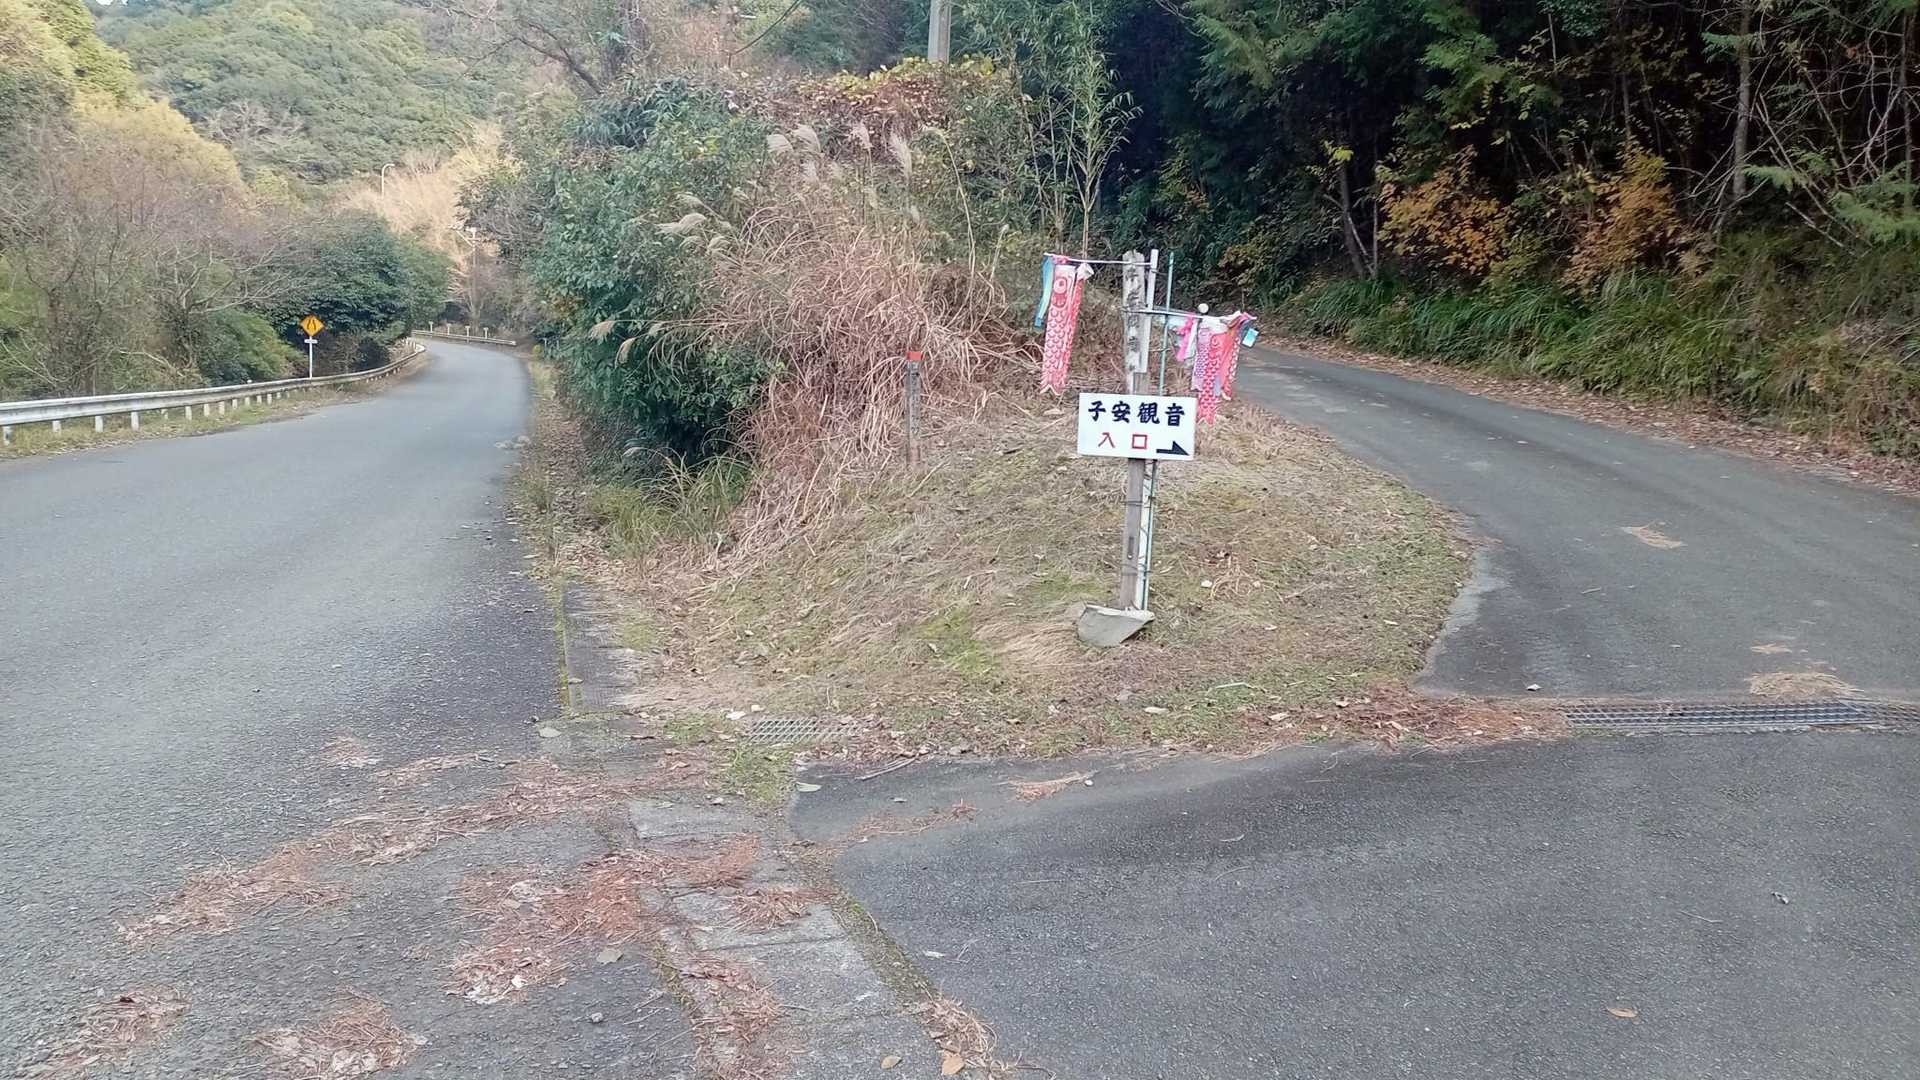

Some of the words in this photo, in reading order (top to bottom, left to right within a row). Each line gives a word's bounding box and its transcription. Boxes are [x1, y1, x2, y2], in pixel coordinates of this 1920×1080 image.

[1088, 400, 1185, 426] 子安観音
[1098, 432, 1148, 450] 入口
